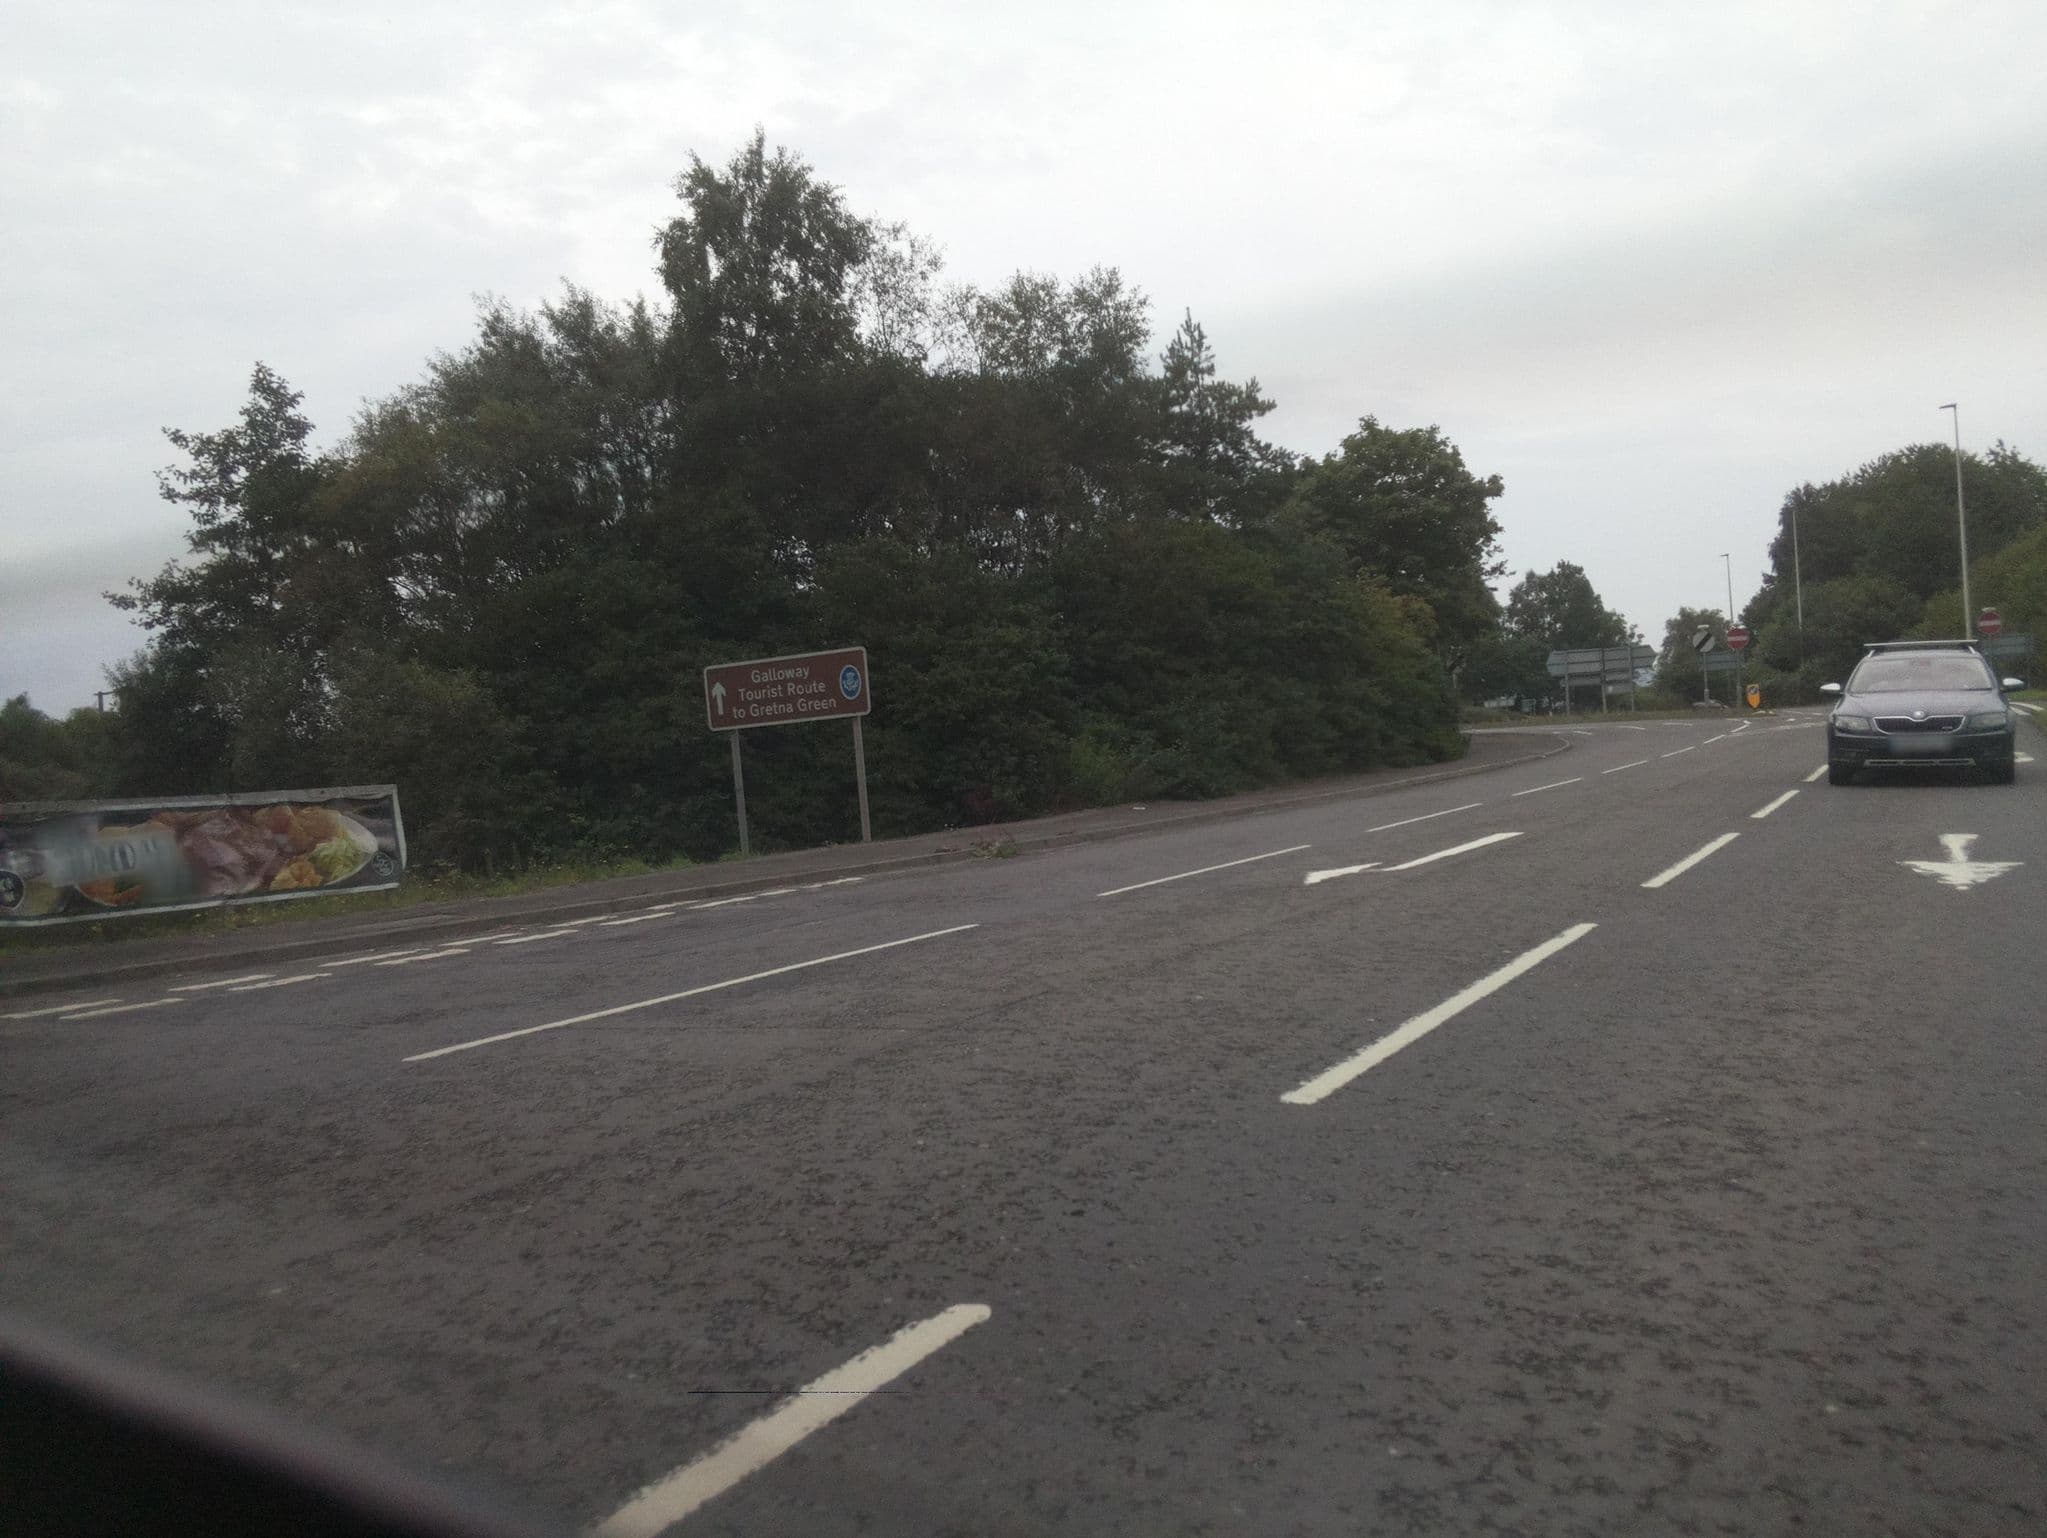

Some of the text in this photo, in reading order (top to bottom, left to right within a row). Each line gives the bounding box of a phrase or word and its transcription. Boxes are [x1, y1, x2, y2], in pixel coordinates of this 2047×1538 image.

[751, 666, 810, 683] Galloway
[738, 681, 826, 702] Tourist Route
[733, 697, 837, 719] to Gretna Green
